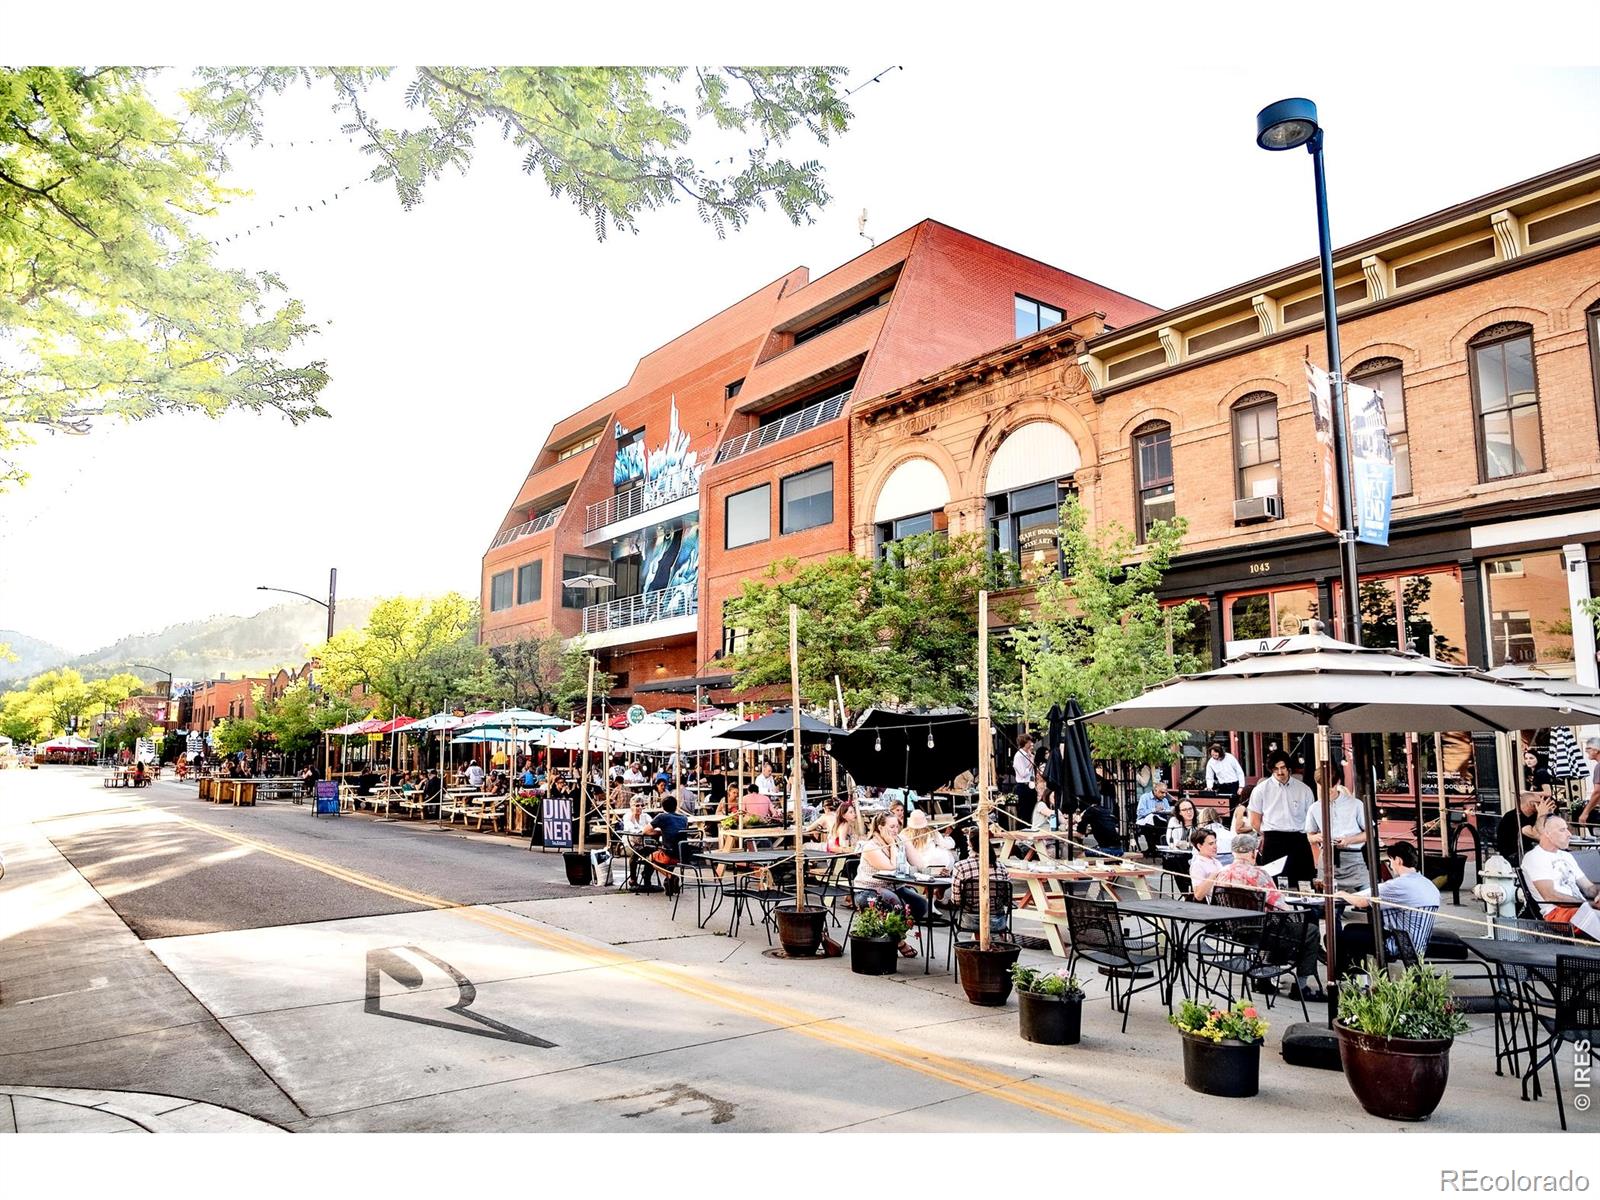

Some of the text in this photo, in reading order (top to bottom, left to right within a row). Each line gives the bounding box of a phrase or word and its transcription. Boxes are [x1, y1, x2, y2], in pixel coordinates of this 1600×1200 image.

[1365, 500, 1385, 521] END
[1249, 562, 1270, 573] 1043
[543, 798, 571, 820] DIN
[544, 821, 572, 841] NER
